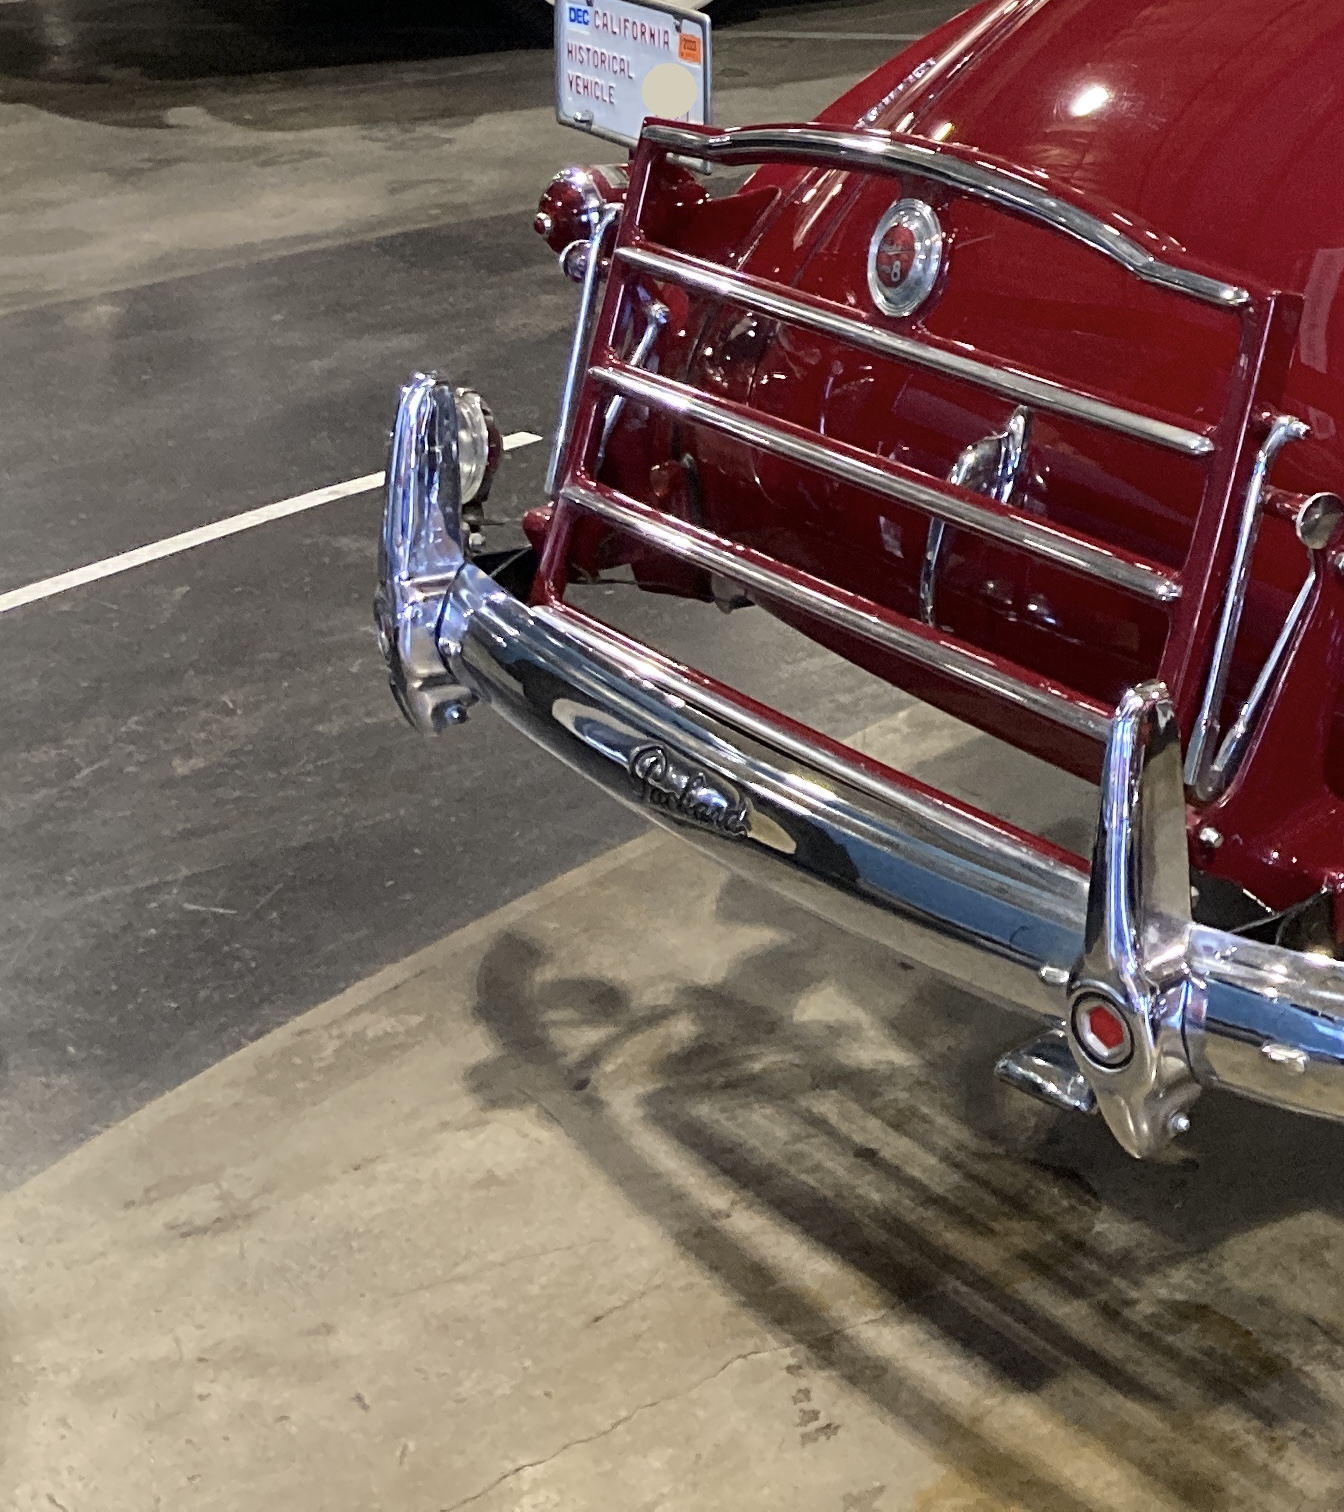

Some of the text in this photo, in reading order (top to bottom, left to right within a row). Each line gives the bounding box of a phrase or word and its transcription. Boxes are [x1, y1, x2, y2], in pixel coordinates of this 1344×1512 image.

[568, 6, 670, 50] DEC CALIFORNIA
[567, 41, 634, 80] HISTORICAL
[567, 71, 616, 105] VEHICLE
